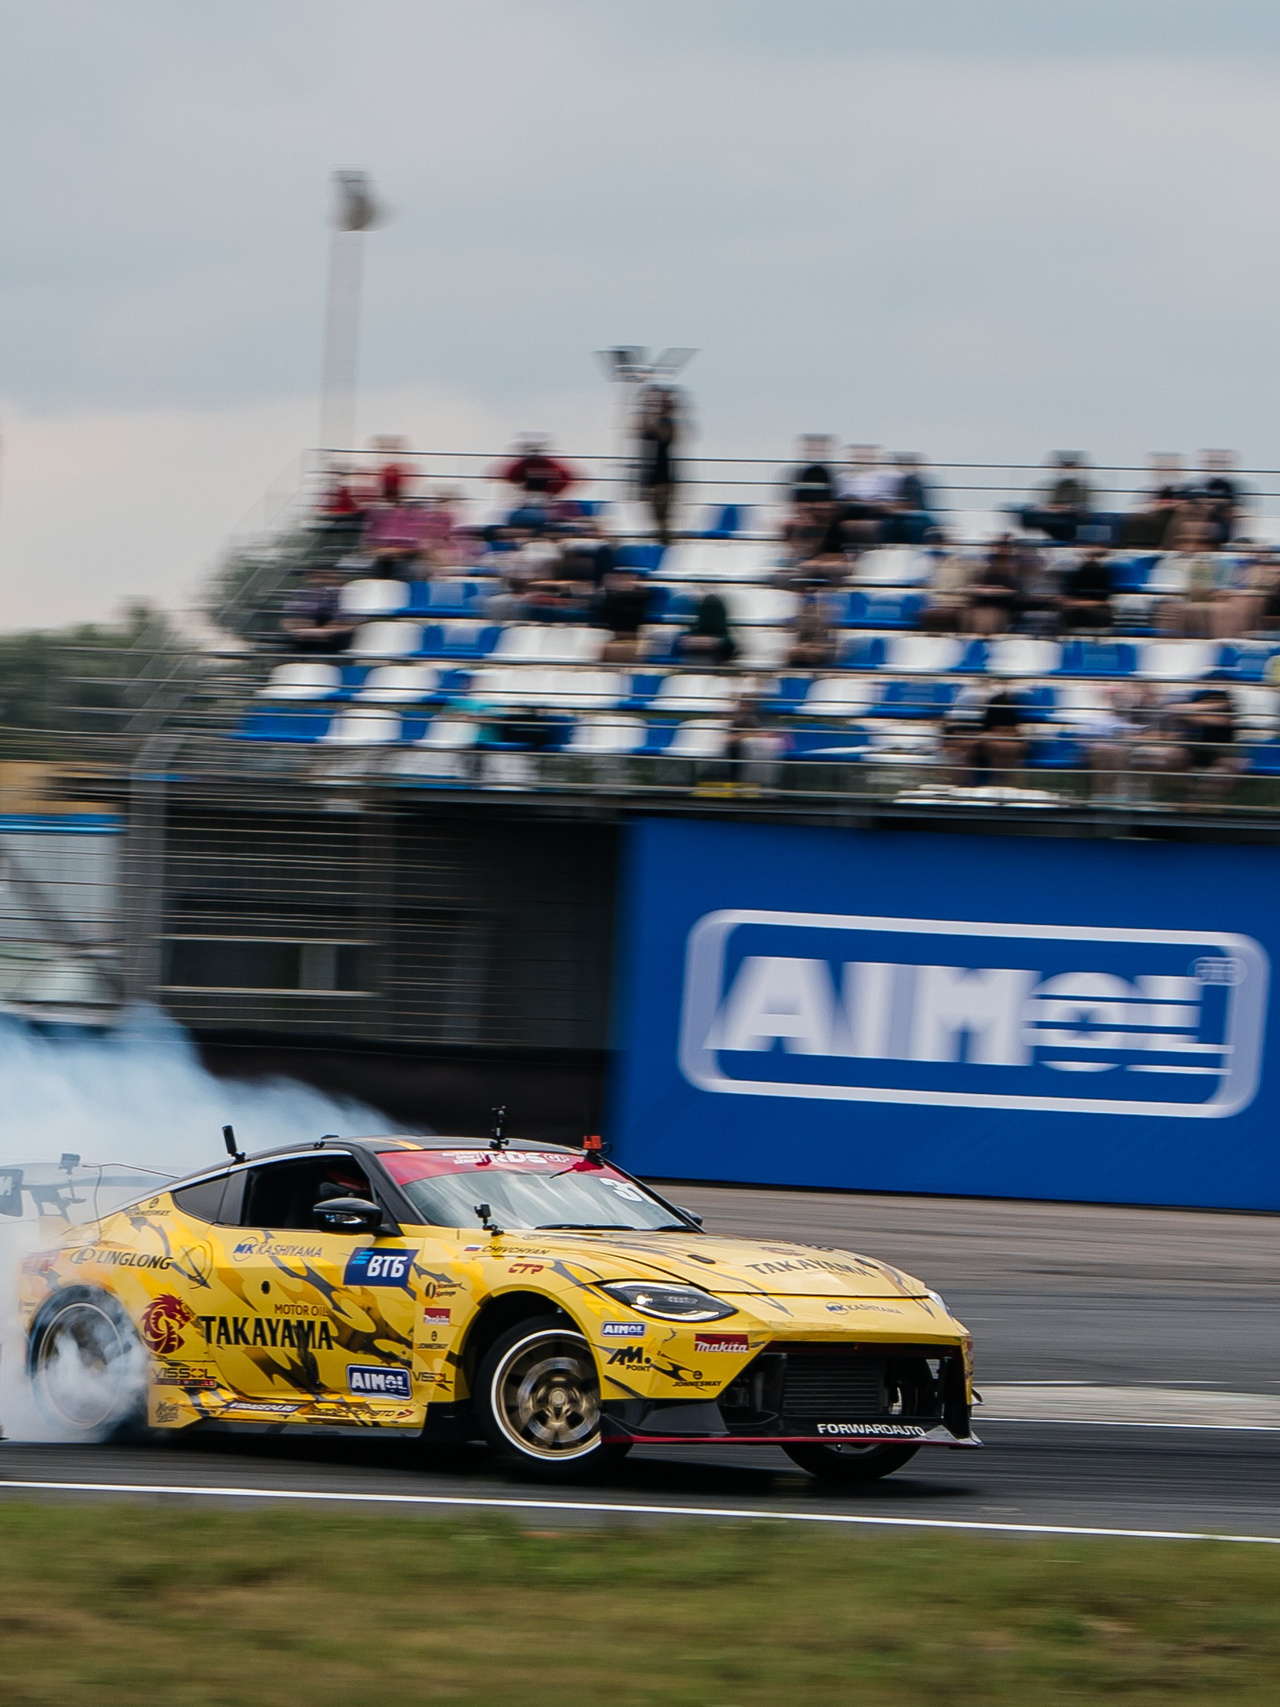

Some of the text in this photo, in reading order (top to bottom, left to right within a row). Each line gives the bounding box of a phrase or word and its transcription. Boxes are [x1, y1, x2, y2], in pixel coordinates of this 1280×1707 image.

[704, 956, 1234, 1075] AIMOL
[255, 1243, 322, 1257] KASHIYAMA
[96, 1250, 174, 1270] LINGLONG
[745, 1258, 878, 1279] TAKAYAMA
[274, 1304, 329, 1317] MOTOR OIL
[198, 1315, 334, 1350] TAKAYAMA
[603, 1325, 645, 1335] AIMOL
[153, 1368, 217, 1379] VISSOL
[626, 1364, 651, 1372] POINT
[351, 1372, 408, 1393] AIMOL
[817, 1423, 927, 1437] FORWARDAUTO
